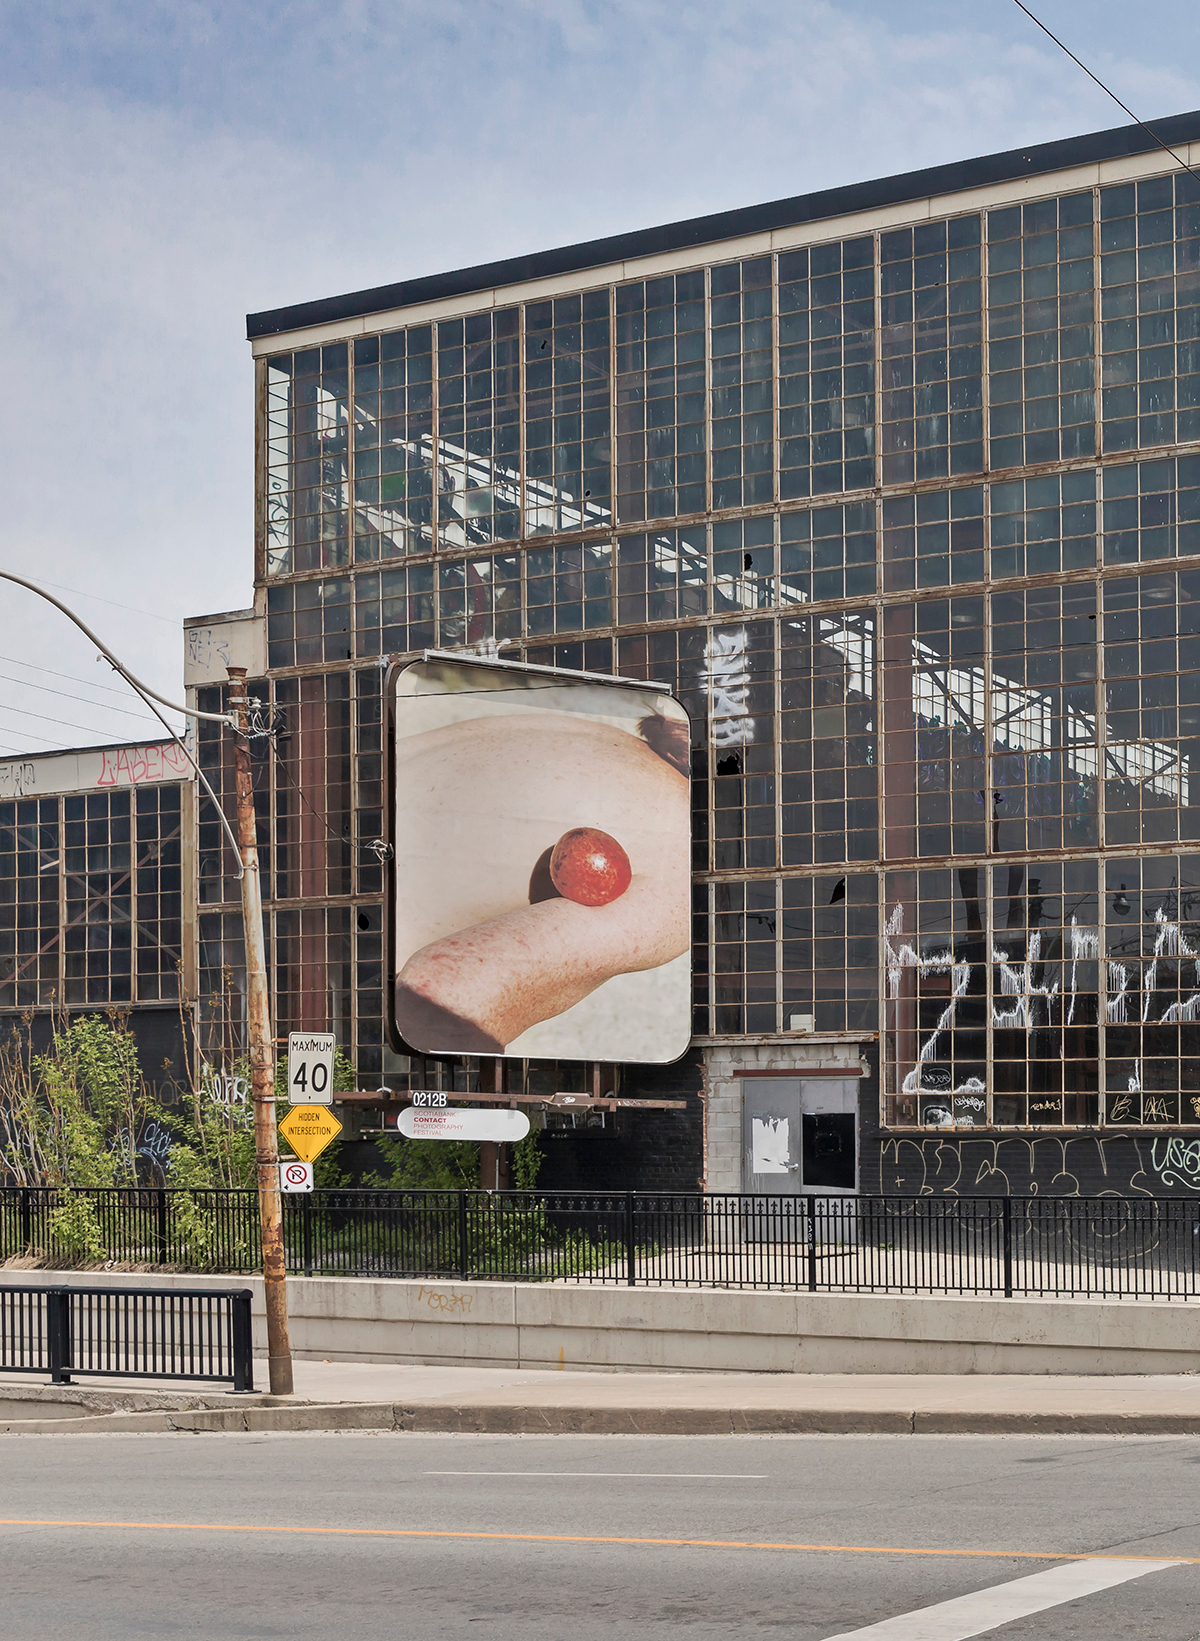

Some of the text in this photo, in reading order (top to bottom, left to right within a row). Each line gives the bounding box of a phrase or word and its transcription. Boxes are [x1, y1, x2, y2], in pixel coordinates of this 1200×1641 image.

[292, 1040, 332, 1051] MAXIMUM
[293, 1062, 328, 1092] 40
[413, 1092, 447, 1107] 0212B
[298, 1112, 320, 1122] HIDDEN
[288, 1126, 332, 1135] INTERSECTION
